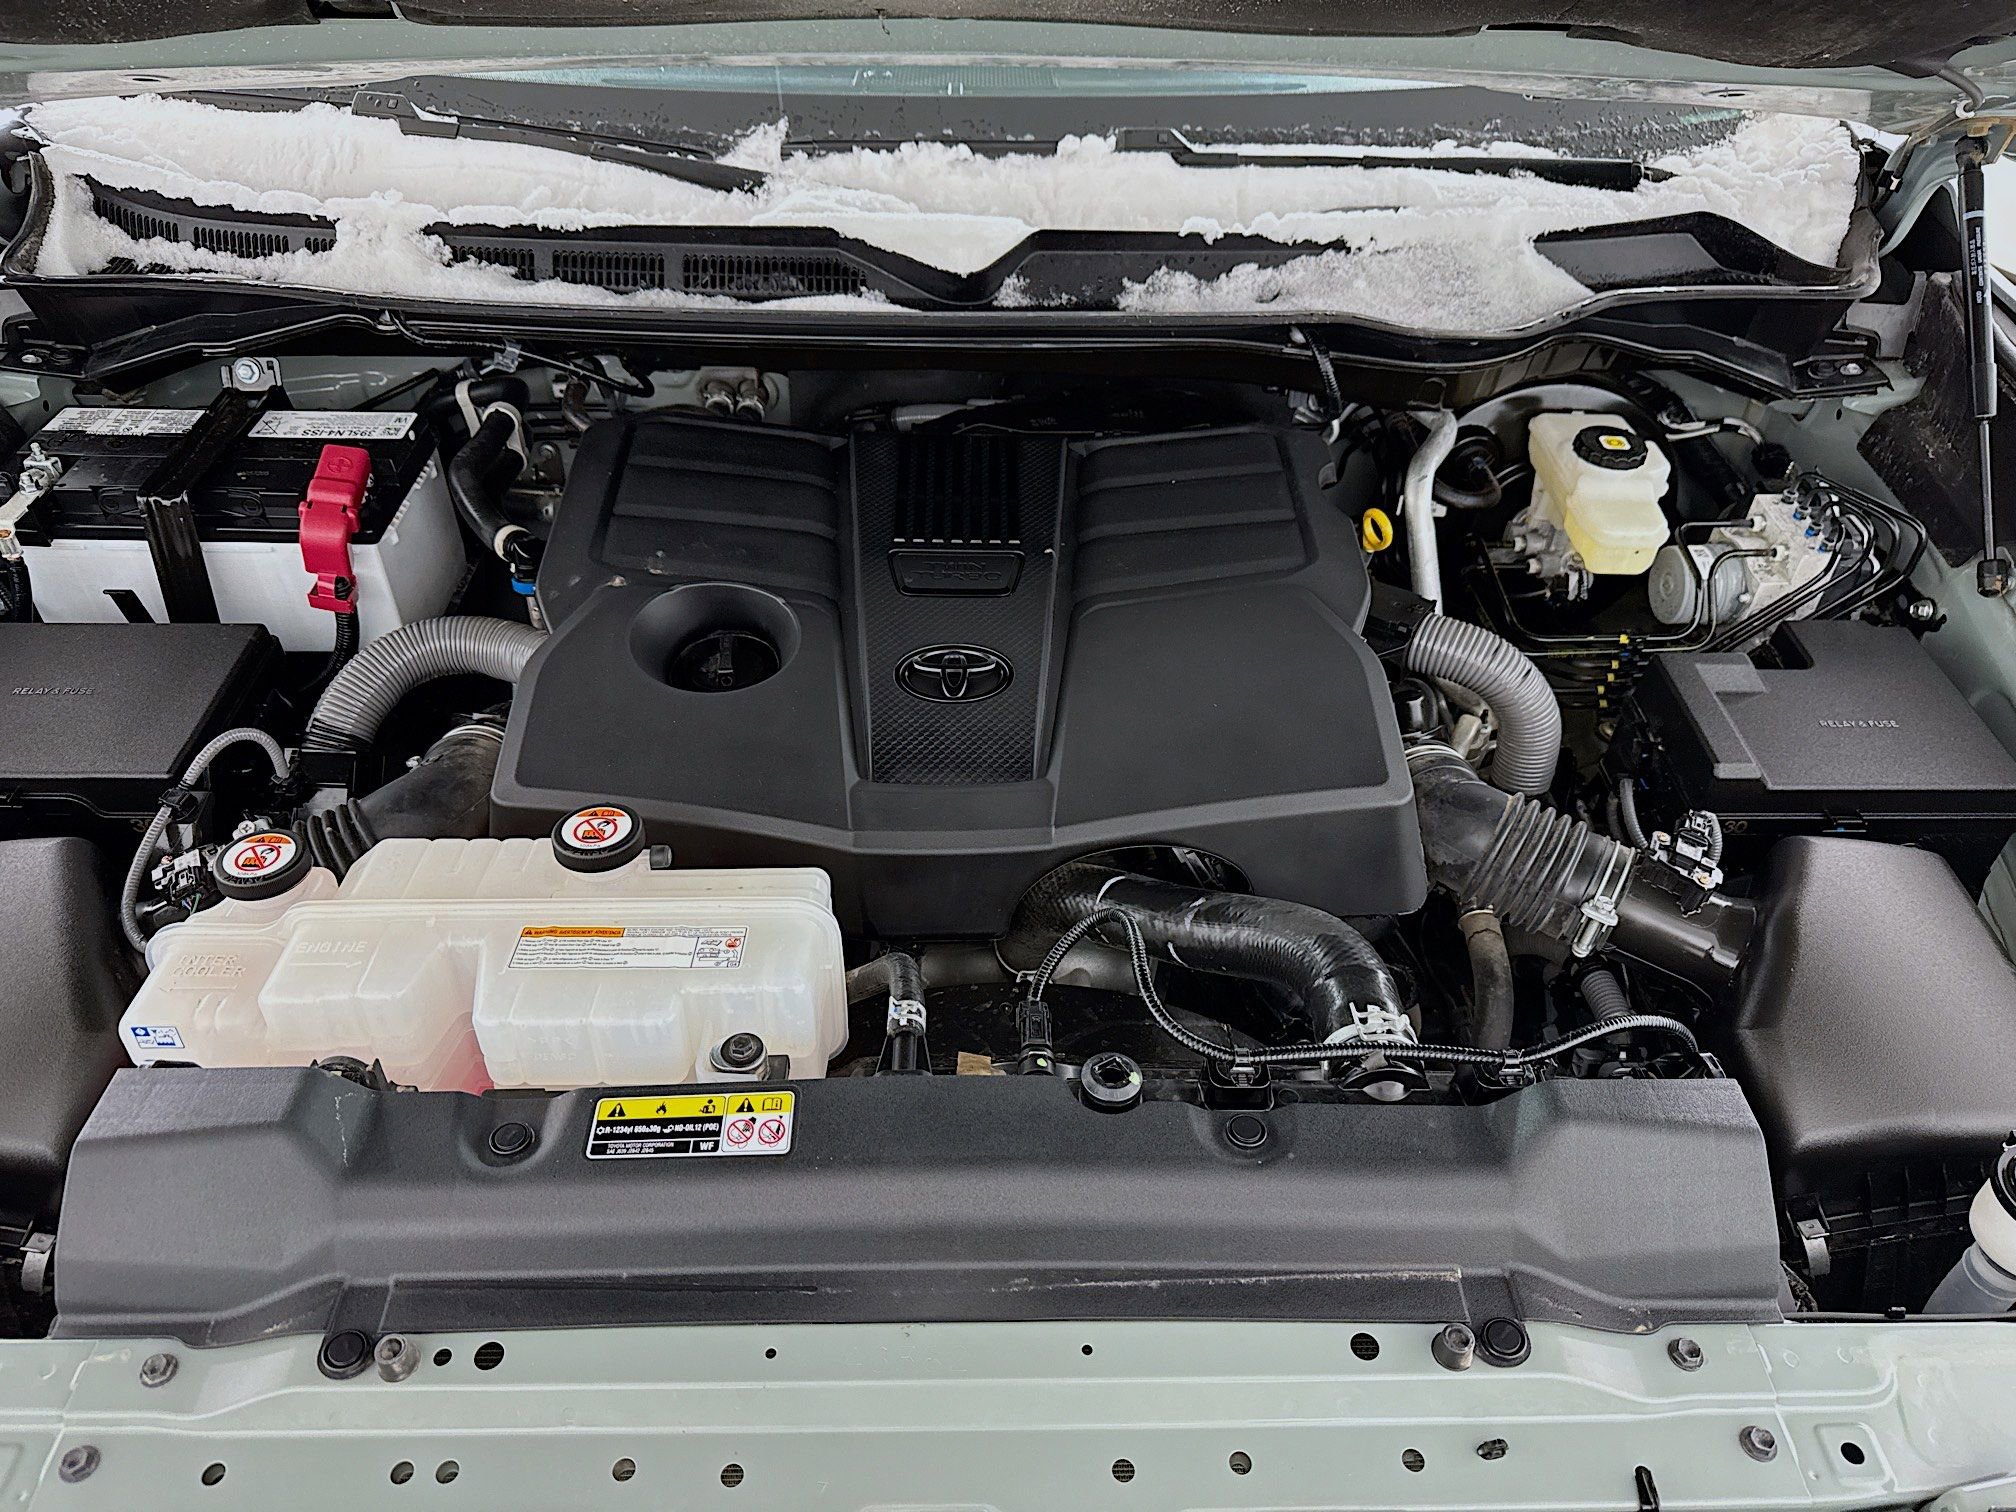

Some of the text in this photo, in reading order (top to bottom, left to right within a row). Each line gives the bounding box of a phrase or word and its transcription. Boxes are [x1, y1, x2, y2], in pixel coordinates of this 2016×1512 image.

[301, 429, 376, 437] 395LN4-ISS
[12, 687, 52, 695] RELAY
[62, 687, 94, 695] FUSE
[1819, 720, 1855, 728] RELAY
[1868, 720, 1899, 728] FUSE
[1723, 820, 1748, 834] 30
[295, 941, 368, 953] ENGINE
[178, 954, 238, 966] INTER
[171, 966, 247, 978] COOLER
[605, 1125, 634, 1134] R-1234yf
[702, 1122, 720, 1132] (POE)
[700, 1142, 714, 1150] WF
